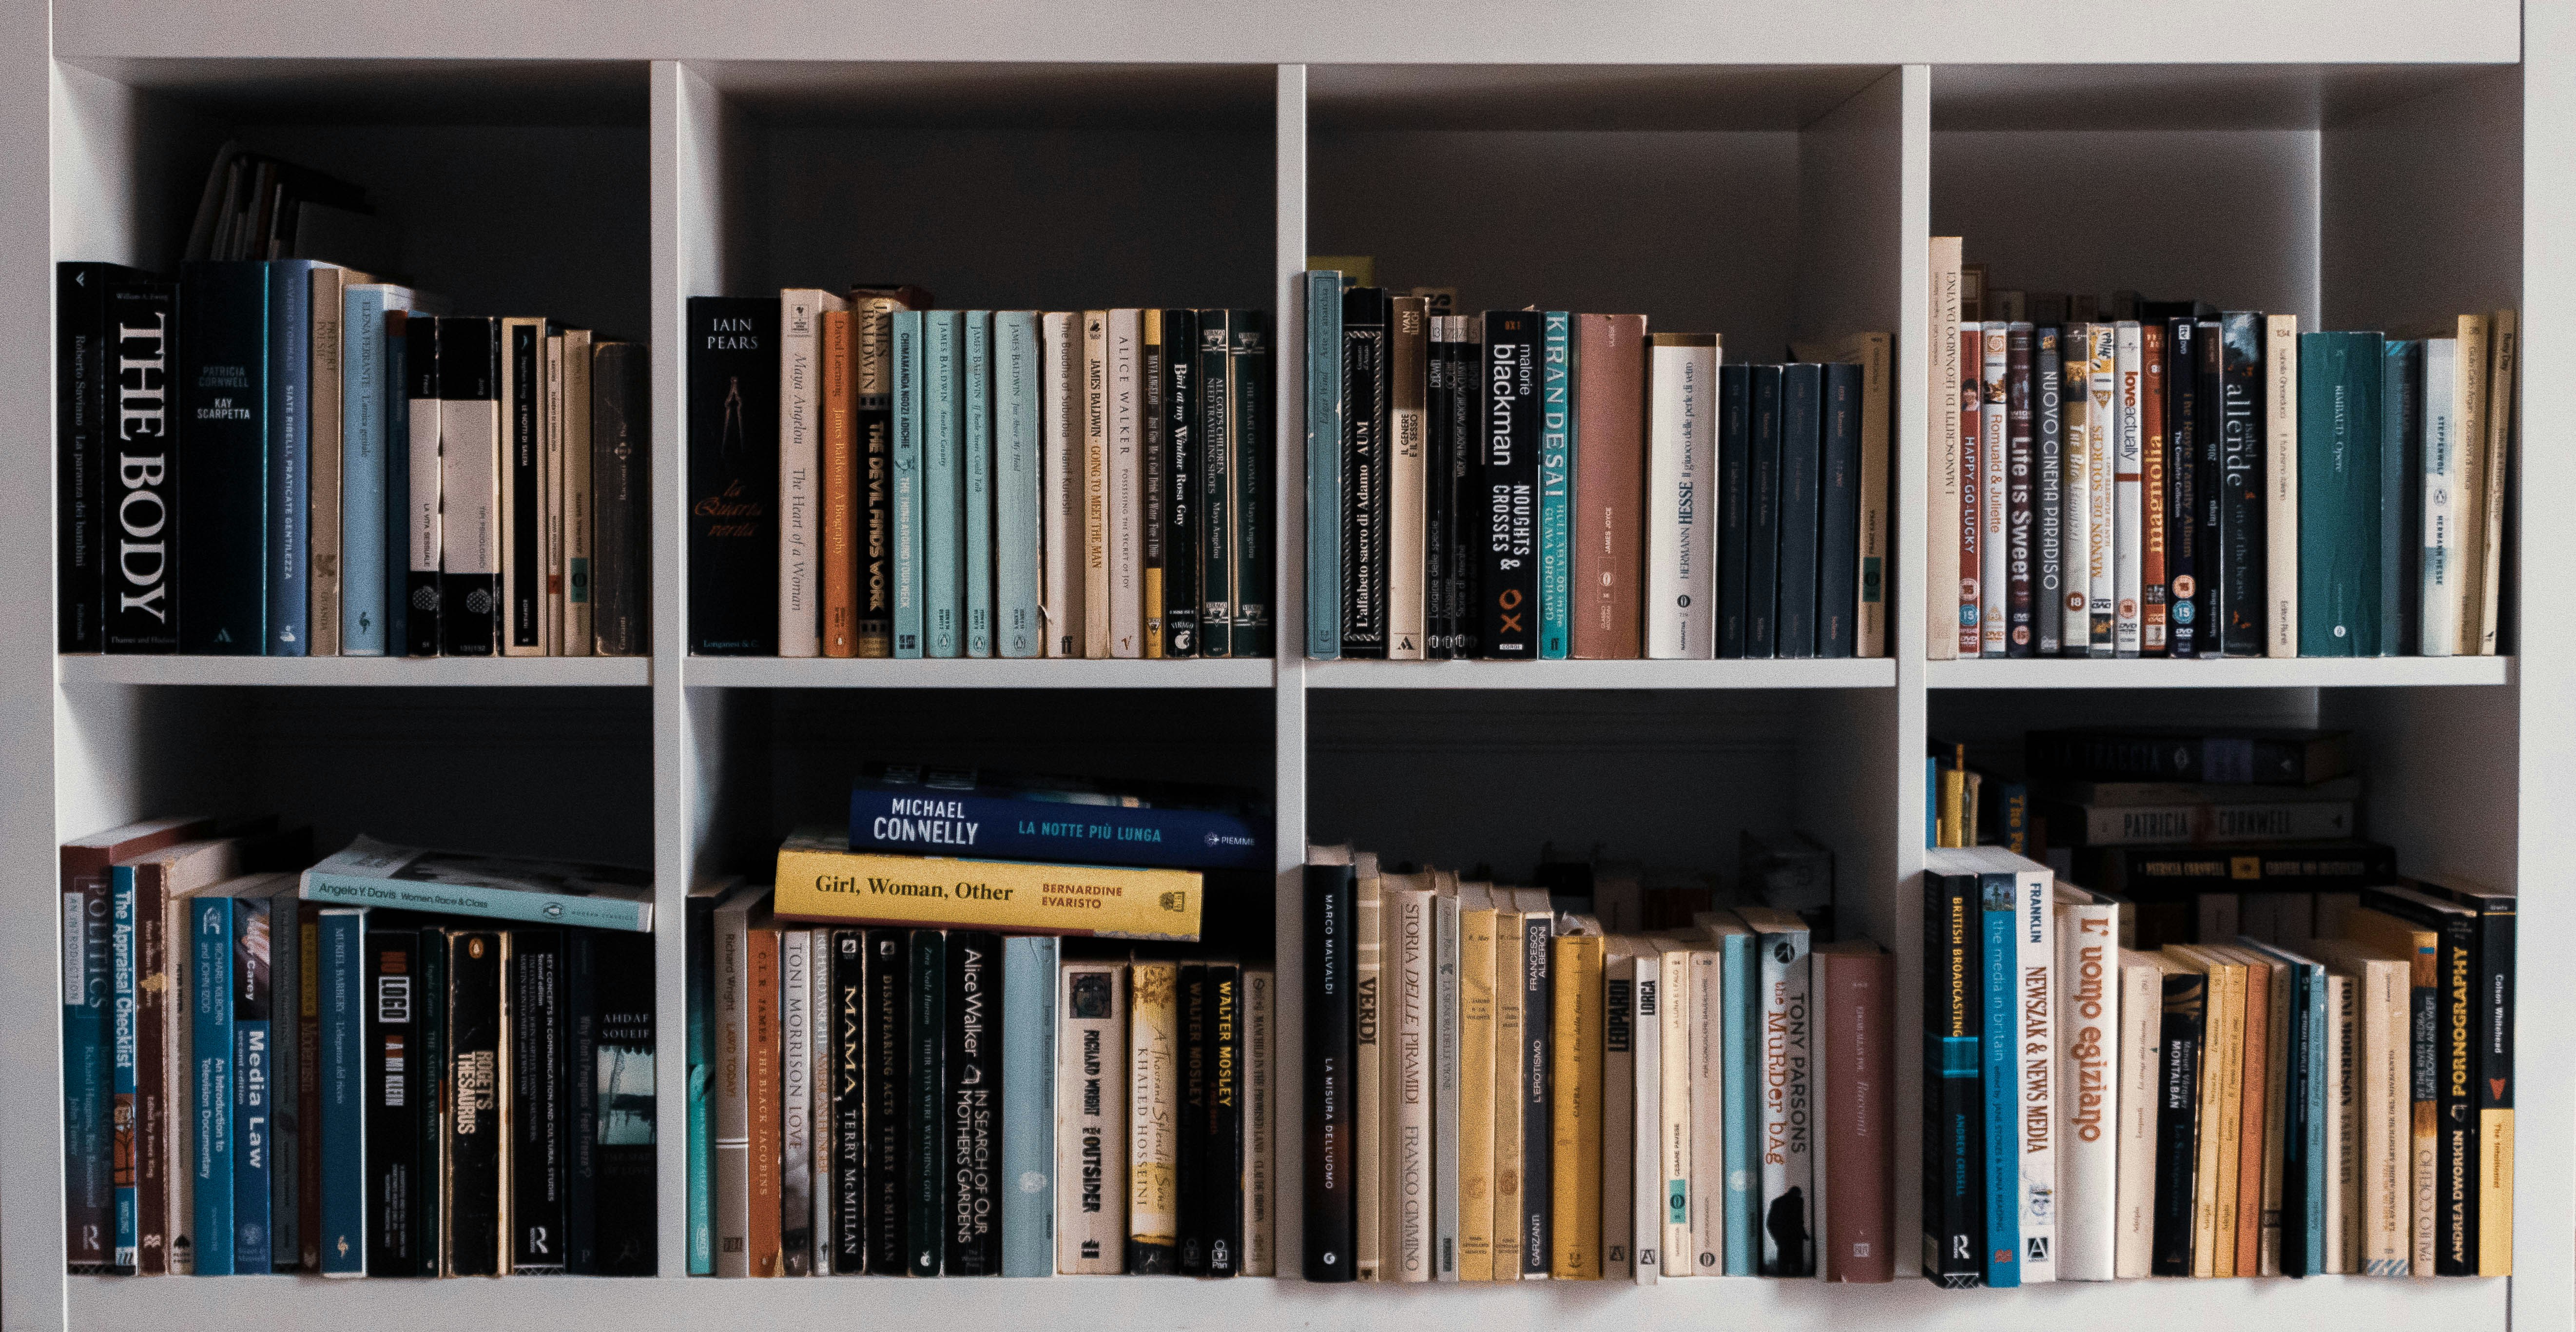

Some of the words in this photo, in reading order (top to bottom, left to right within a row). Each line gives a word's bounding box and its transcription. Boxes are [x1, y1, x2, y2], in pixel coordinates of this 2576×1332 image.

[708, 336, 757, 349] PEARS
[714, 318, 751, 331] IAIN
[862, 310, 874, 389] BALDWIN
[876, 304, 890, 357] JAMES
[120, 313, 165, 440] THE
[793, 353, 806, 390] Maya
[901, 333, 910, 388] CHIMAMANDA
[1091, 359, 1101, 390] JAMES
[1119, 337, 1129, 381] ALICE
[1520, 344, 1532, 395] malorie
[1546, 316, 1565, 403] KIRAN
[198, 408, 250, 419] SCARPETTA
[215, 398, 232, 408] KAY
[792, 395, 807, 444] Angelou
[901, 391, 910, 414] NGOZI
[1091, 392, 1101, 437] BALDWIN
[1120, 392, 1130, 454] WALKER
[1493, 344, 1515, 465] blackman
[2043, 370, 2058, 435] NUOVO
[869, 423, 883, 452] THE
[901, 417, 910, 448] ADICHIE
[1546, 413, 1564, 496] DESAI
[1990, 414, 2002, 474] Romuald
[2013, 436, 2031, 476] Life
[2227, 384, 2253, 486] allende
[2244, 424, 2256, 457] isabel
[793, 468, 806, 490] The
[869, 457, 882, 507] DEVIL
[1091, 446, 1101, 477] GOING
[1091, 479, 1102, 492] TO
[2043, 439, 2058, 501] CINEMA
[424, 503, 429, 511] LA
[793, 496, 805, 529] Heart
[1091, 495, 1102, 521] MEET
[1493, 485, 1510, 551] CROSSES
[1679, 482, 1693, 524] HESSE
[1964, 436, 1975, 553] HAPPY-GO-LUCKY
[1990, 487, 2002, 532] Juliette
[2013, 484, 2028, 503] is
[2146, 435, 2164, 552] magnolia
[120, 452, 165, 623] BODY
[789, 533, 805, 544] of
[870, 509, 882, 557] FINDS
[1091, 524, 1102, 542] THE
[1513, 485, 1530, 555] NOUGHTS
[1092, 546, 1102, 568] MAN
[1500, 559, 1520, 569] &
[1680, 528, 1690, 579] HERMANN
[2013, 510, 2031, 582] Sweet
[2043, 506, 2058, 590] PARADISO
[792, 562, 804, 610] Woman
[870, 561, 883, 610] WORK
[1962, 610, 1974, 619] 15
[2179, 607, 2189, 616] 15
[874, 818, 978, 844] CONNELLY
[890, 798, 964, 819] MICHAEL
[1019, 821, 1035, 834] LA
[1042, 823, 1083, 838] NOTTE
[1089, 823, 1111, 839] PIÙ
[1118, 827, 1161, 842] LUNGA
[116, 891, 133, 920] The
[816, 876, 860, 895] Girl,
[868, 878, 948, 899] Woman,
[955, 882, 1013, 900] Other
[1042, 896, 1101, 909] EVARISTO
[1043, 883, 1122, 897] BERNARDINE
[2031, 883, 2041, 943] FRANKLIN
[89, 884, 106, 1008] POLITICS
[1404, 904, 1419, 962] STORIA
[1953, 897, 1962, 944] BRITISH
[1993, 920, 2004, 943] the
[113, 923, 133, 995] Appraisal
[789, 943, 802, 989] TONI
[1530, 927, 1538, 991] FRANCESCO
[1993, 950, 2005, 992] media
[2073, 946, 2103, 1019] uomo
[382, 979, 407, 1019] LOGO
[1190, 982, 1201, 1040] WALTER
[1220, 981, 1231, 1040] WALTER
[1358, 977, 1376, 1045] VERDI
[1403, 969, 1419, 1023] DELLE
[1641, 980, 1656, 1016] LORCA
[1952, 948, 1963, 1038] BROADCASTING
[1994, 997, 2003, 1009] in
[2026, 966, 2047, 1038] NEWSZAK
[2496, 974, 2504, 1003] Colson
[116, 999, 131, 1068] Checklist
[845, 987, 856, 1094] MAMA
[883, 975, 893, 1075] DISAPPEARING
[1789, 991, 1806, 1048] TONY
[1993, 1013, 2005, 1061] britain
[2453, 947, 2467, 1096] PORNOGRAPHY
[2495, 1007, 2503, 1053] Whitehead
[250, 1031, 264, 1105] Media
[789, 999, 802, 1097] MORRISON
[1084, 1030, 1100, 1076] RICHARD
[1325, 1058, 1333, 1072] LA
[1404, 1033, 1419, 1104] PIRAMIDI
[1533, 1039, 1542, 1102] L'EROTISMO
[2026, 1042, 2047, 1055] &
[458, 1052, 476, 1134] THESAURUS
[477, 1051, 494, 1110] ROGET'S
[884, 1082, 893, 1115] ACTS
[975, 1090, 988, 1105] IN
[1085, 1079, 1100, 1116] WRIGHT
[1137, 1048, 1148, 1116] KHALED
[1189, 1047, 1201, 1106] MOSLEY
[1219, 1046, 1231, 1106] MOSLEY
[1325, 1077, 1334, 1119] MISURA
[2027, 1059, 2048, 1101] NEWS
[2071, 1027, 2107, 1142] egiziano
[789, 1106, 803, 1149] LOVE
[957, 1090, 972, 1166] MOTHERS'
[1791, 1057, 1806, 1153] PARSONS
[2027, 1105, 2048, 1153] MEDIA
[250, 1117, 264, 1168] Law
[845, 1110, 856, 1161] TERRY
[884, 1126, 894, 1170] TERRY
[975, 1106, 989, 1170] SEARCH
[1325, 1125, 1334, 1189] DELL'UOMO
[1404, 1126, 1419, 1195] FRANCO
[975, 1175, 988, 1197] OF
[1083, 1136, 1101, 1212] OUTSIDER
[1137, 1124, 1148, 1205] HOSSEINI
[2453, 1131, 2463, 1198] DWORKIN
[845, 1169, 856, 1254] McMILLAN
[885, 1182, 894, 1260] McMILLAN
[957, 1173, 973, 1243] GARDENS
[974, 1202, 990, 1234] OUR
[2453, 1202, 2463, 1262] ANDREA
[1403, 1201, 1419, 1271] CIMMINO
[1532, 1214, 1541, 1266] GARZANTI
